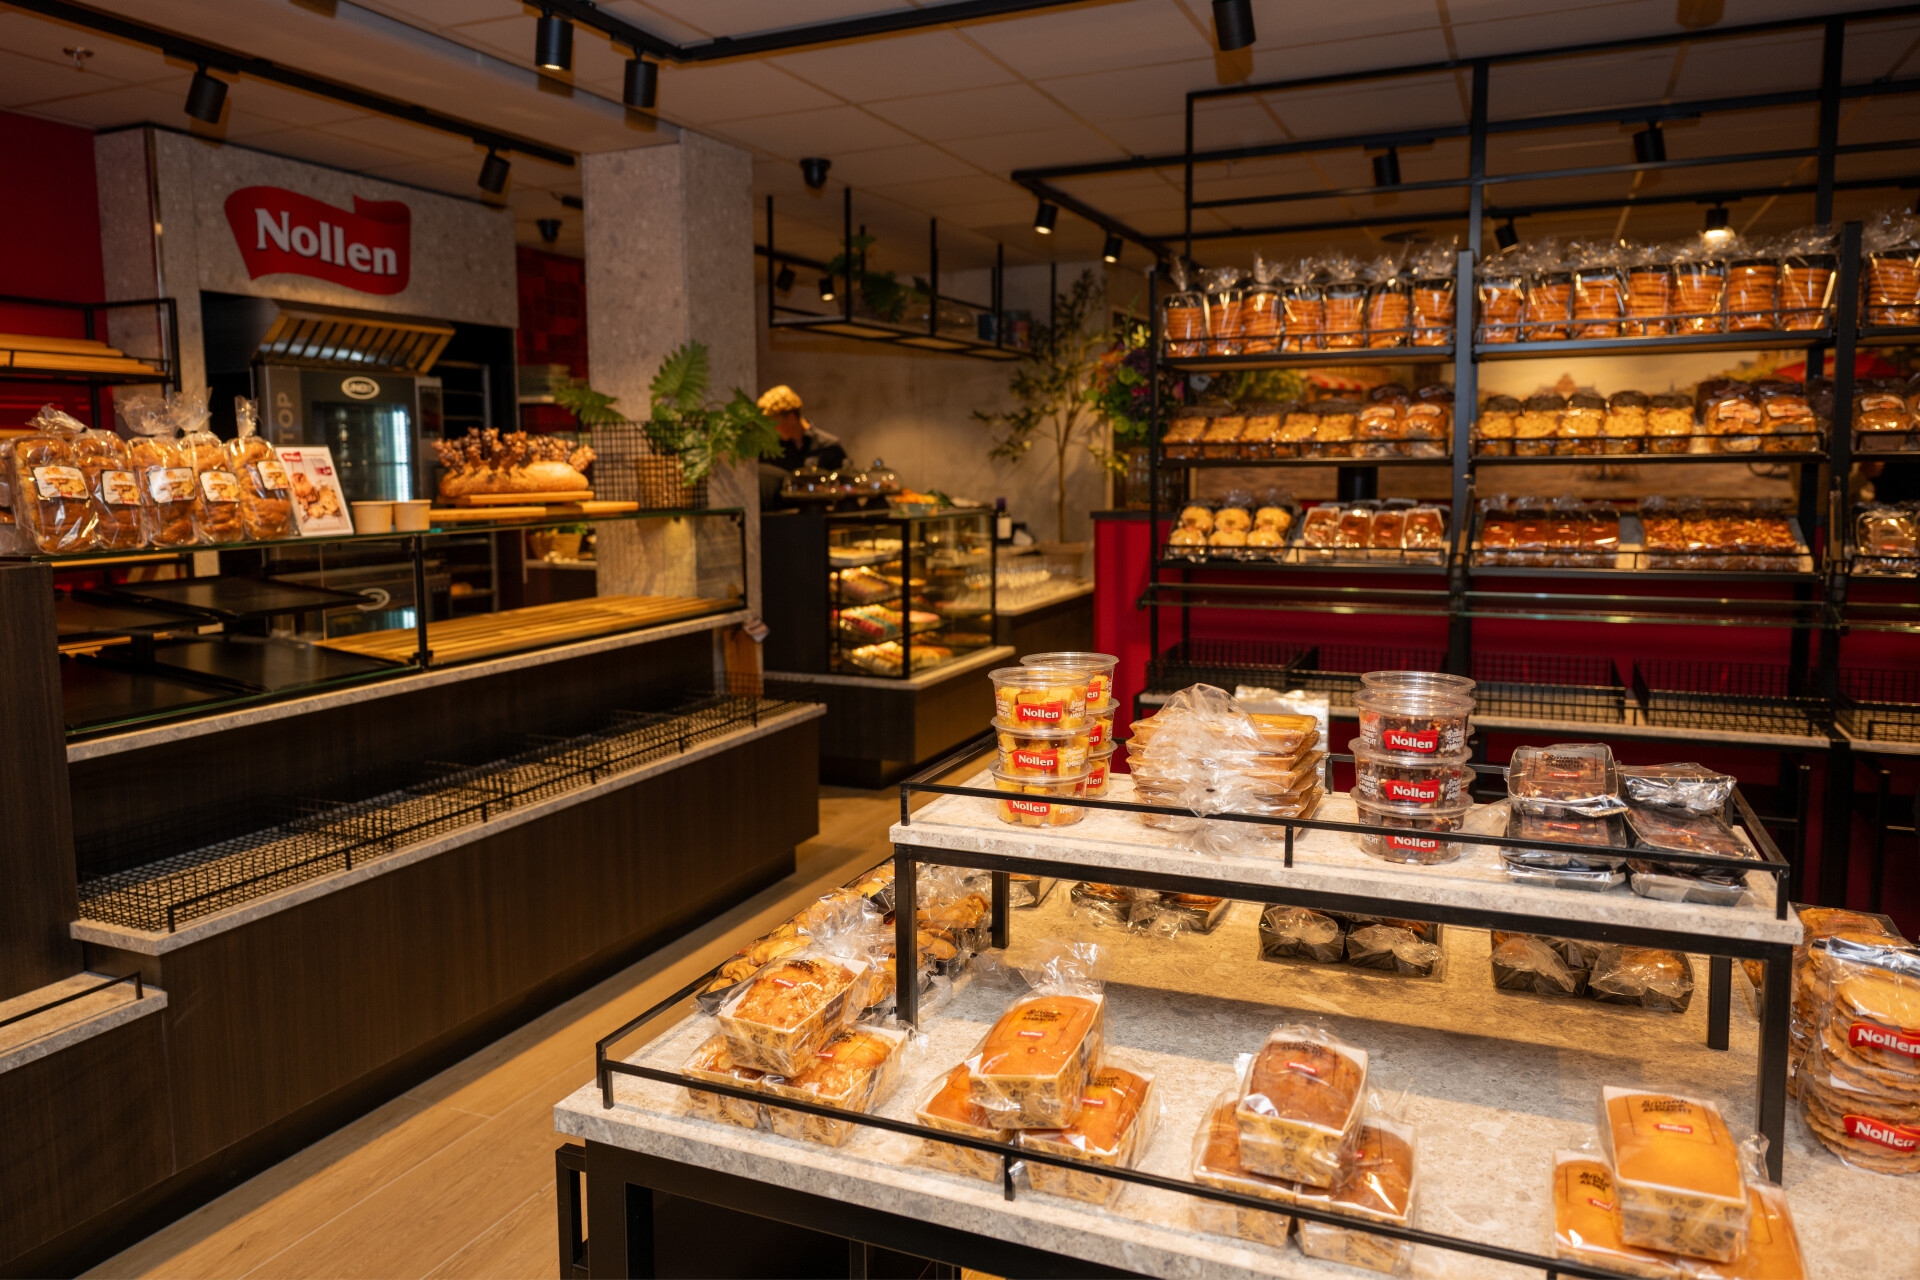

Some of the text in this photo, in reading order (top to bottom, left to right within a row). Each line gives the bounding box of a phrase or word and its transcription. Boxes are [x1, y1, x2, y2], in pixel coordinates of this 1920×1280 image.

[254, 207, 398, 276] Nollen
[1022, 707, 1059, 719] Nollen
[1391, 735, 1434, 749] Nollen
[1018, 754, 1054, 766] Nollen
[1393, 785, 1435, 799] Nollen
[1012, 800, 1047, 812] Nollen
[1394, 835, 1436, 849] Nollen
[1857, 1028, 1920, 1054] Nollen
